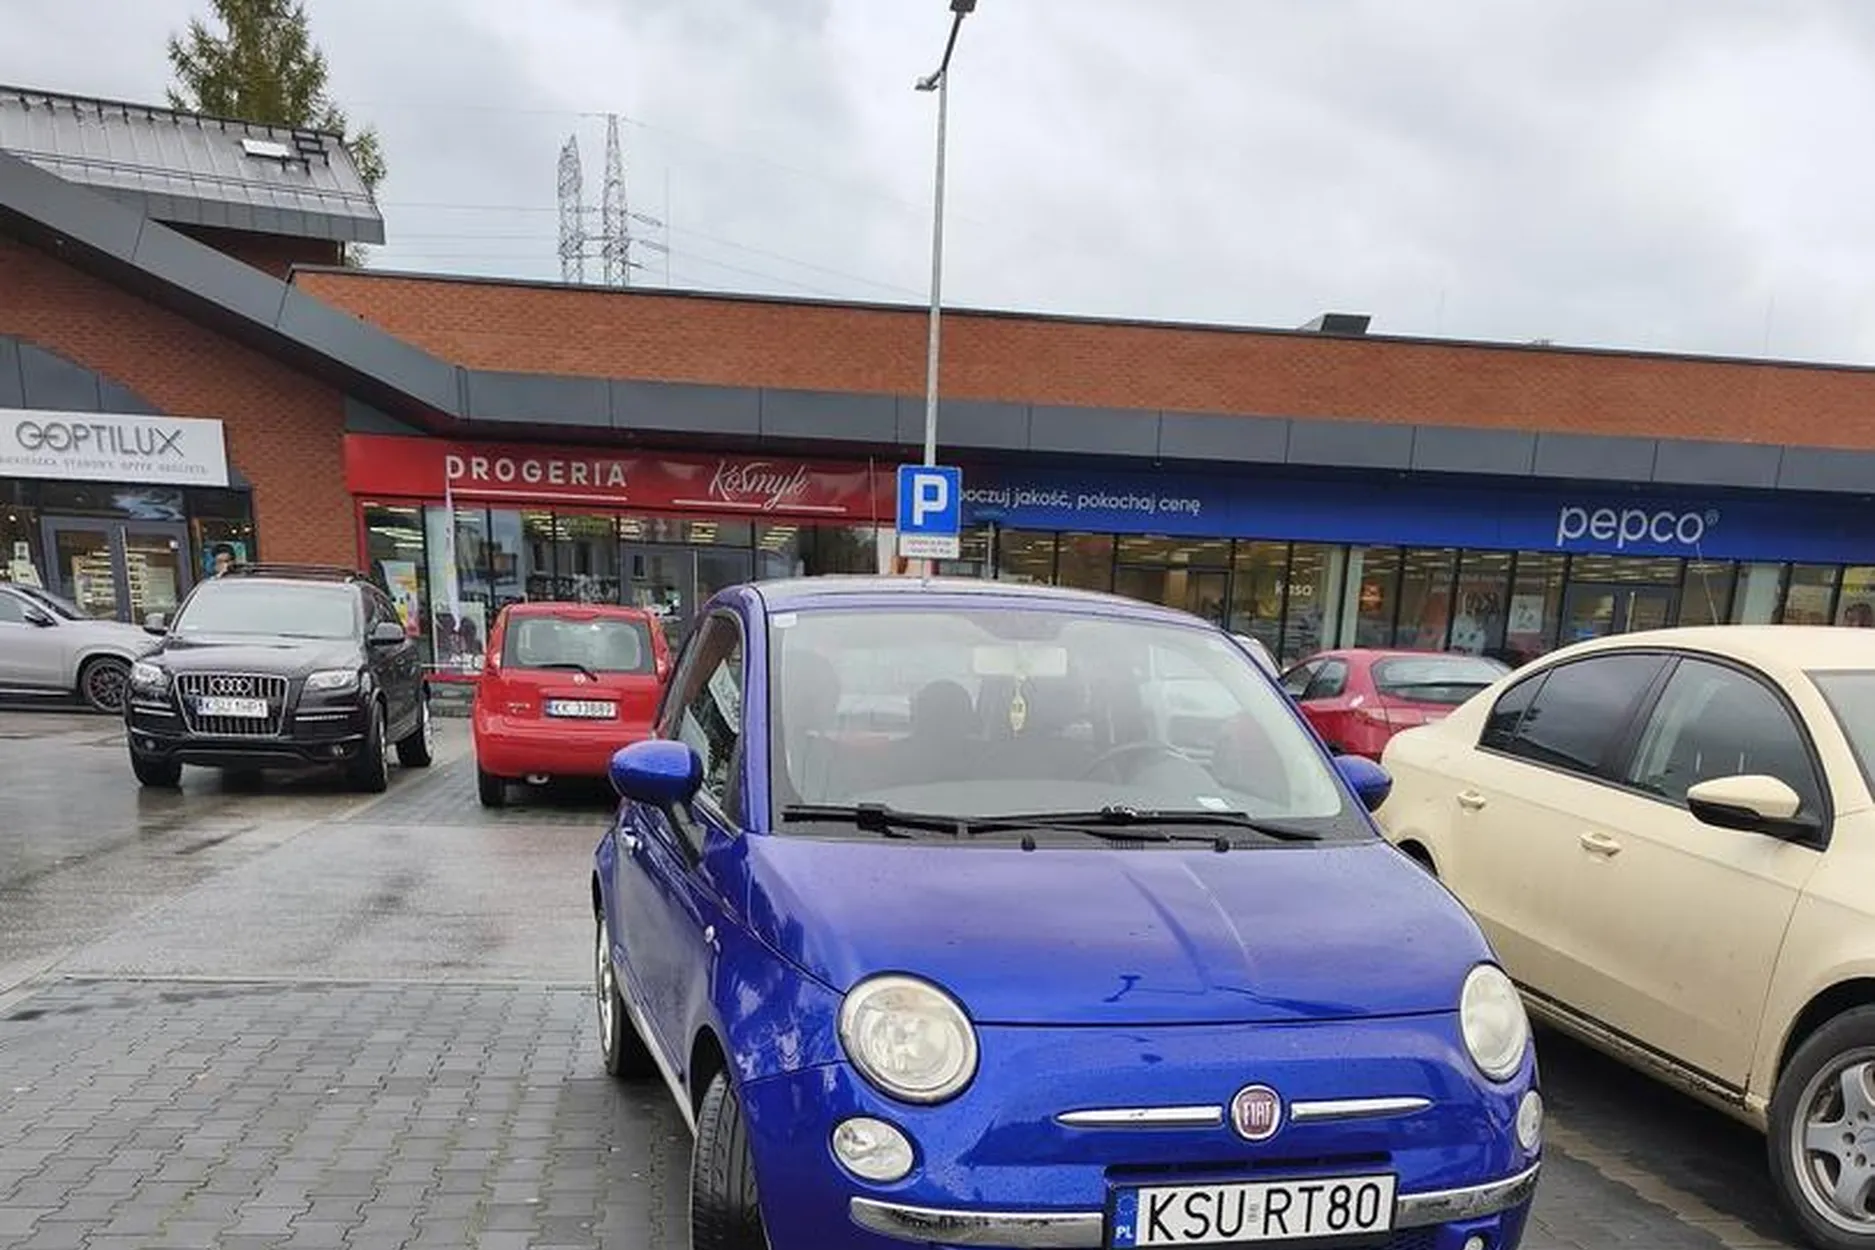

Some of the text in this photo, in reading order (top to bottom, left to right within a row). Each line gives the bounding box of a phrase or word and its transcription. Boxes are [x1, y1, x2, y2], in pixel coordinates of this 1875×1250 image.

[446, 455, 627, 487] DROGERIA
[914, 473, 948, 526] P
[1077, 492, 1155, 514] pokochaj
[1159, 498, 1201, 515] cenę
[1243, 1099, 1273, 1126] FIAT
[1116, 1183, 1381, 1241] PL KSU RT80
